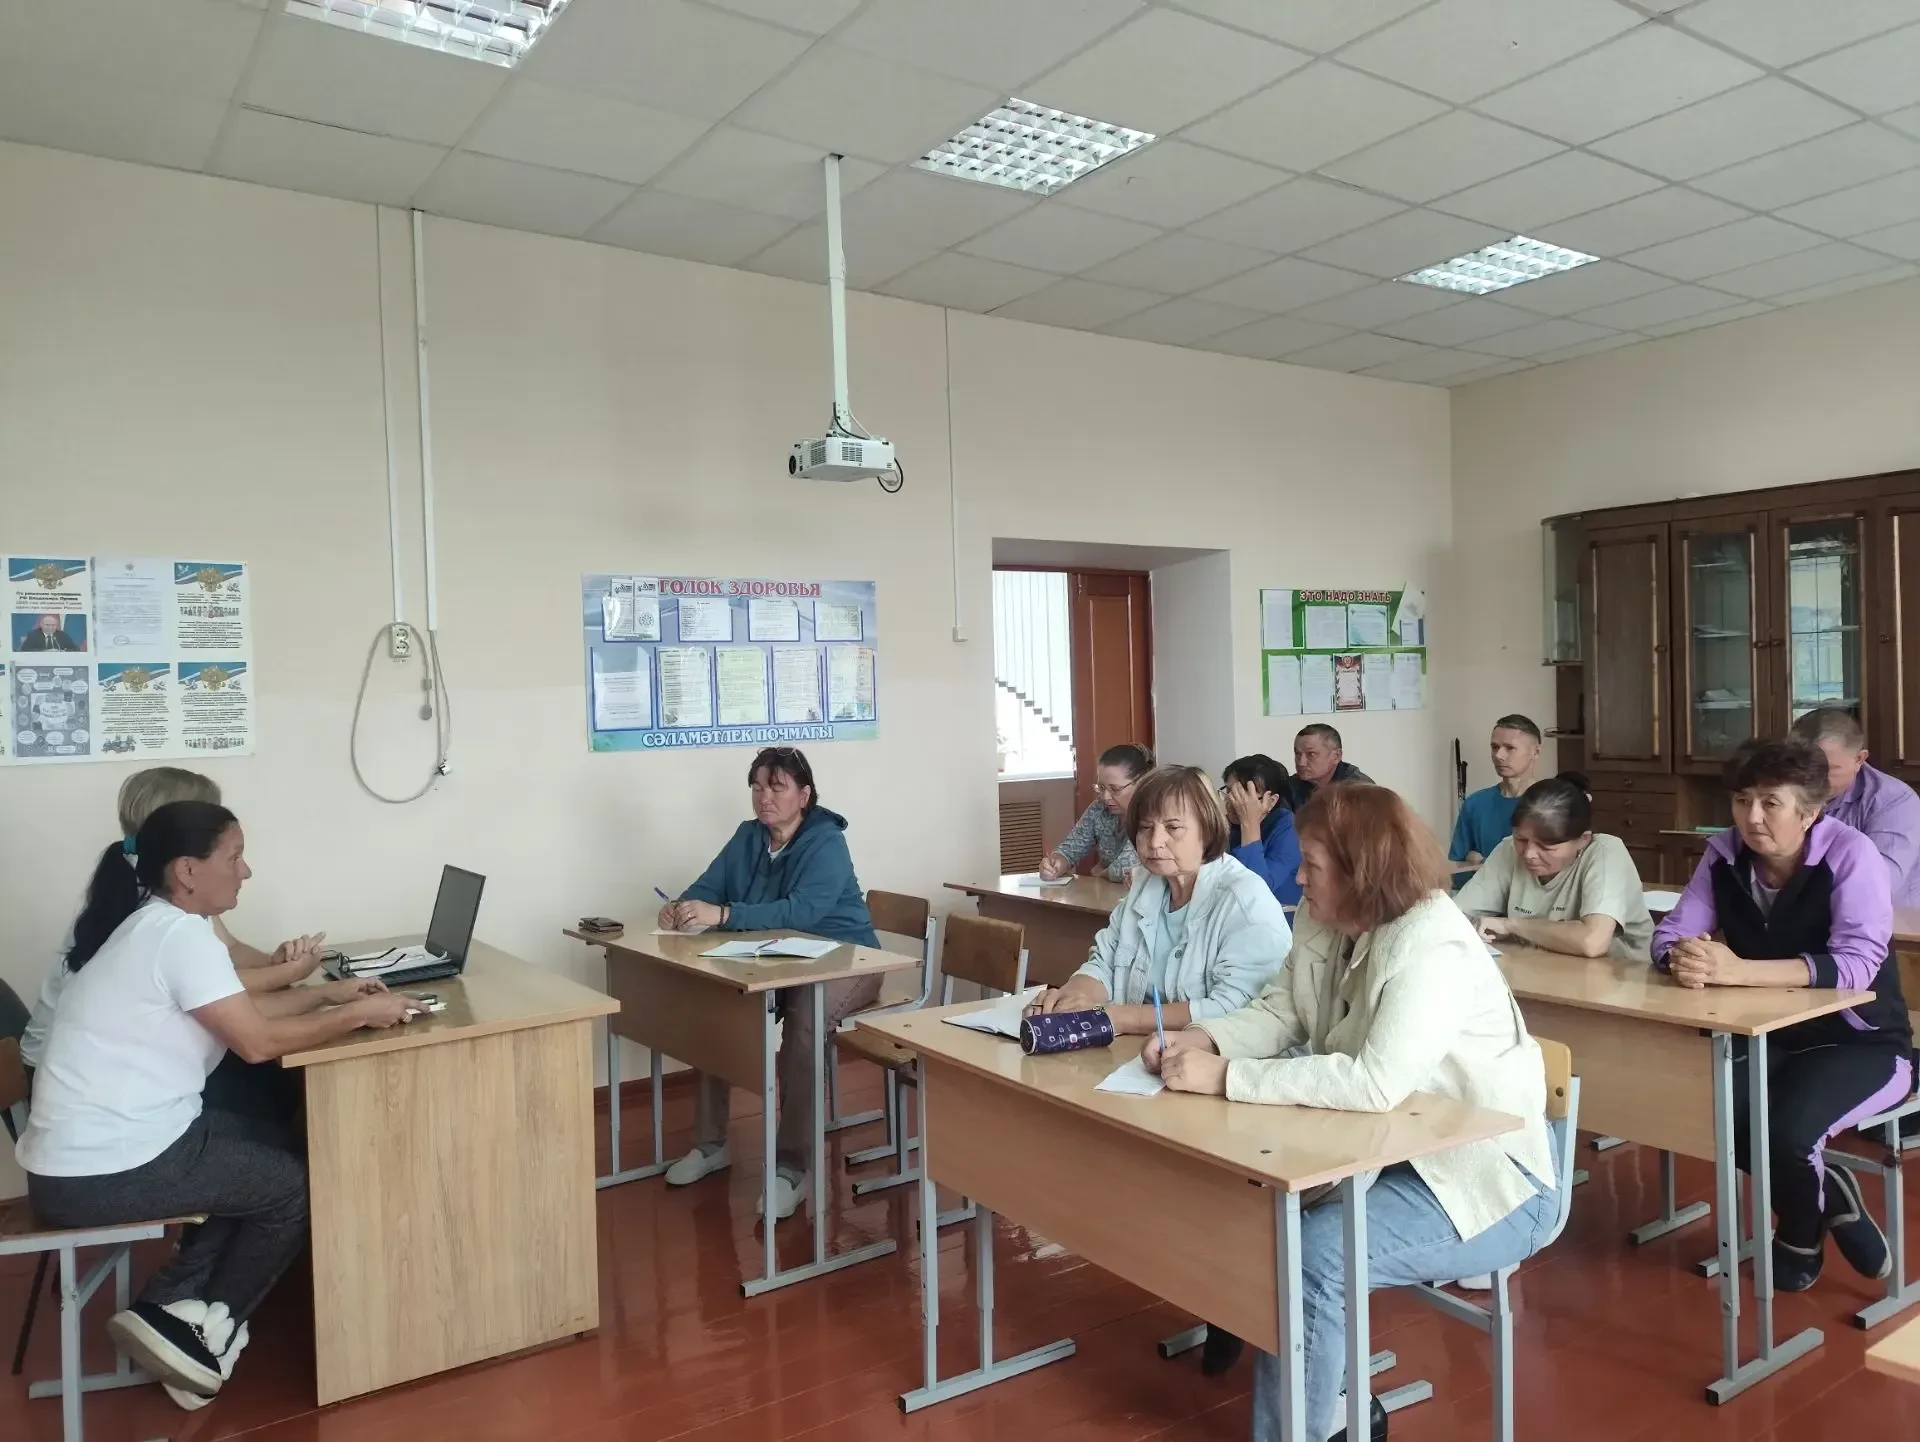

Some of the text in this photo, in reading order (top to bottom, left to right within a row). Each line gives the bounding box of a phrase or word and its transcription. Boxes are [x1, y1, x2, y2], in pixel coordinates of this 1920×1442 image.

[658, 579, 724, 595] ГОЛОК
[729, 580, 821, 597] ЗДОРОВЬЯ
[1301, 591, 1391, 603] ЭТО НАДО ЗНАТЬ
[643, 725, 834, 747] СӘЛАМӘТЛЕК ПОЧМАГЫ
